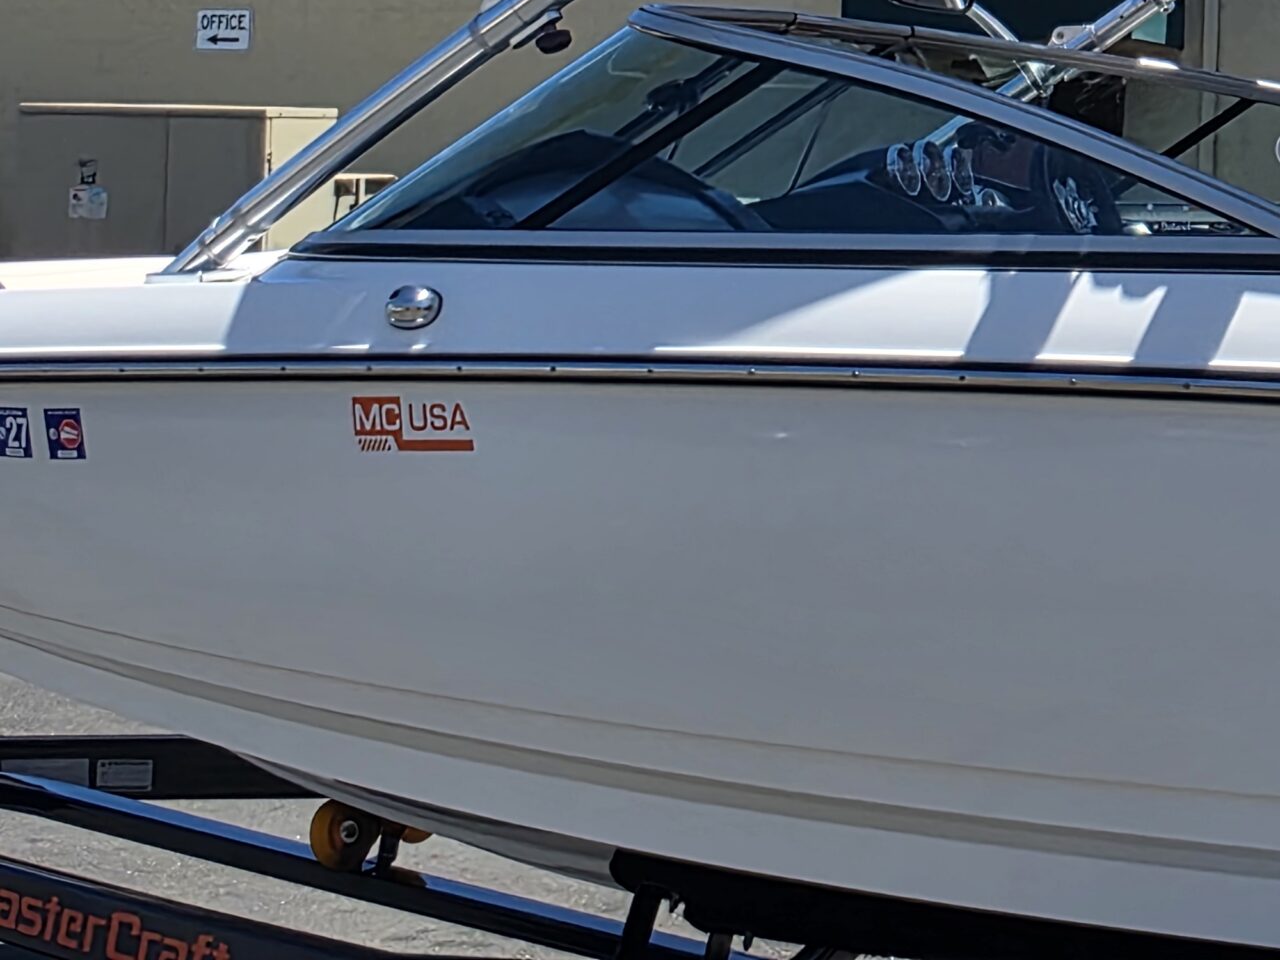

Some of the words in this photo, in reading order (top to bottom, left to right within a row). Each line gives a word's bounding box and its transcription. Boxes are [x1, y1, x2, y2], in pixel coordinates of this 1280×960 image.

[201, 14, 247, 30] OFFICE
[354, 403, 401, 431] MC
[408, 402, 470, 431] USA
[6, 416, 27, 448] 27
